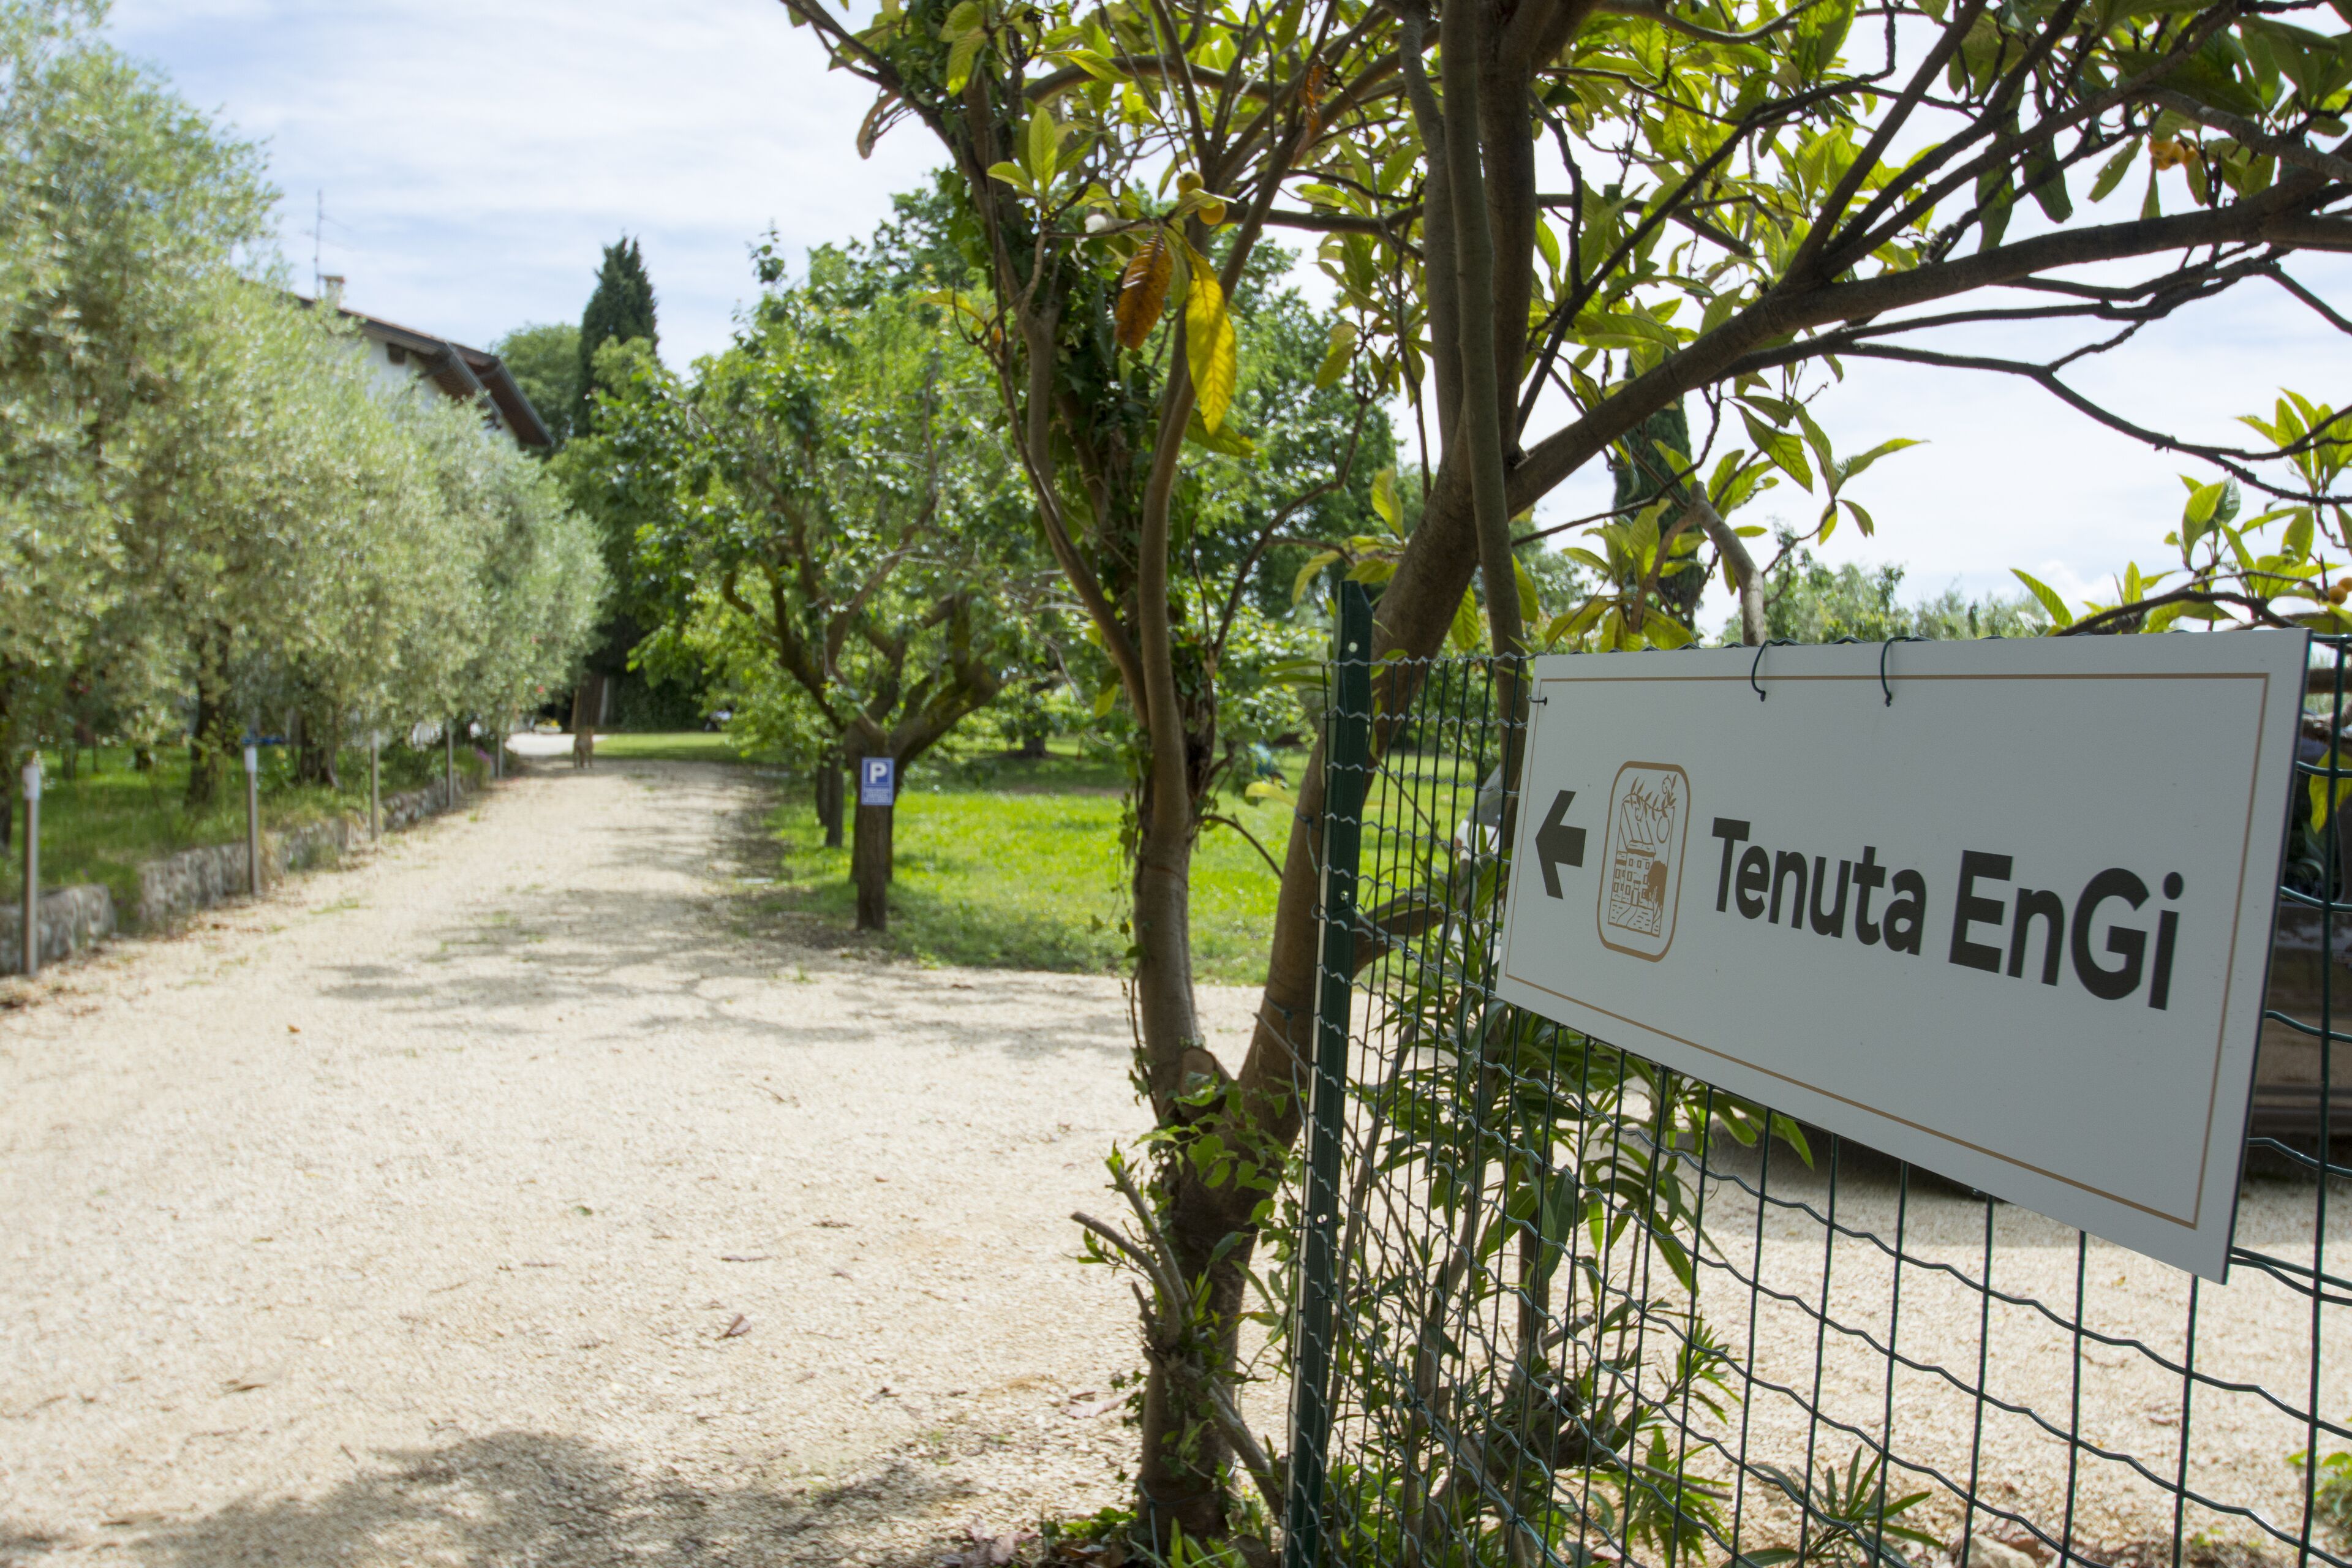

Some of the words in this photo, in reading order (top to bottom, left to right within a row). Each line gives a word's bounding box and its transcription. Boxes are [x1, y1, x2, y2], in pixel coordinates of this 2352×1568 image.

[870, 762, 887, 784] P
[1712, 817, 1927, 956] Tenuta
[1948, 850, 2184, 1011] EnGi
